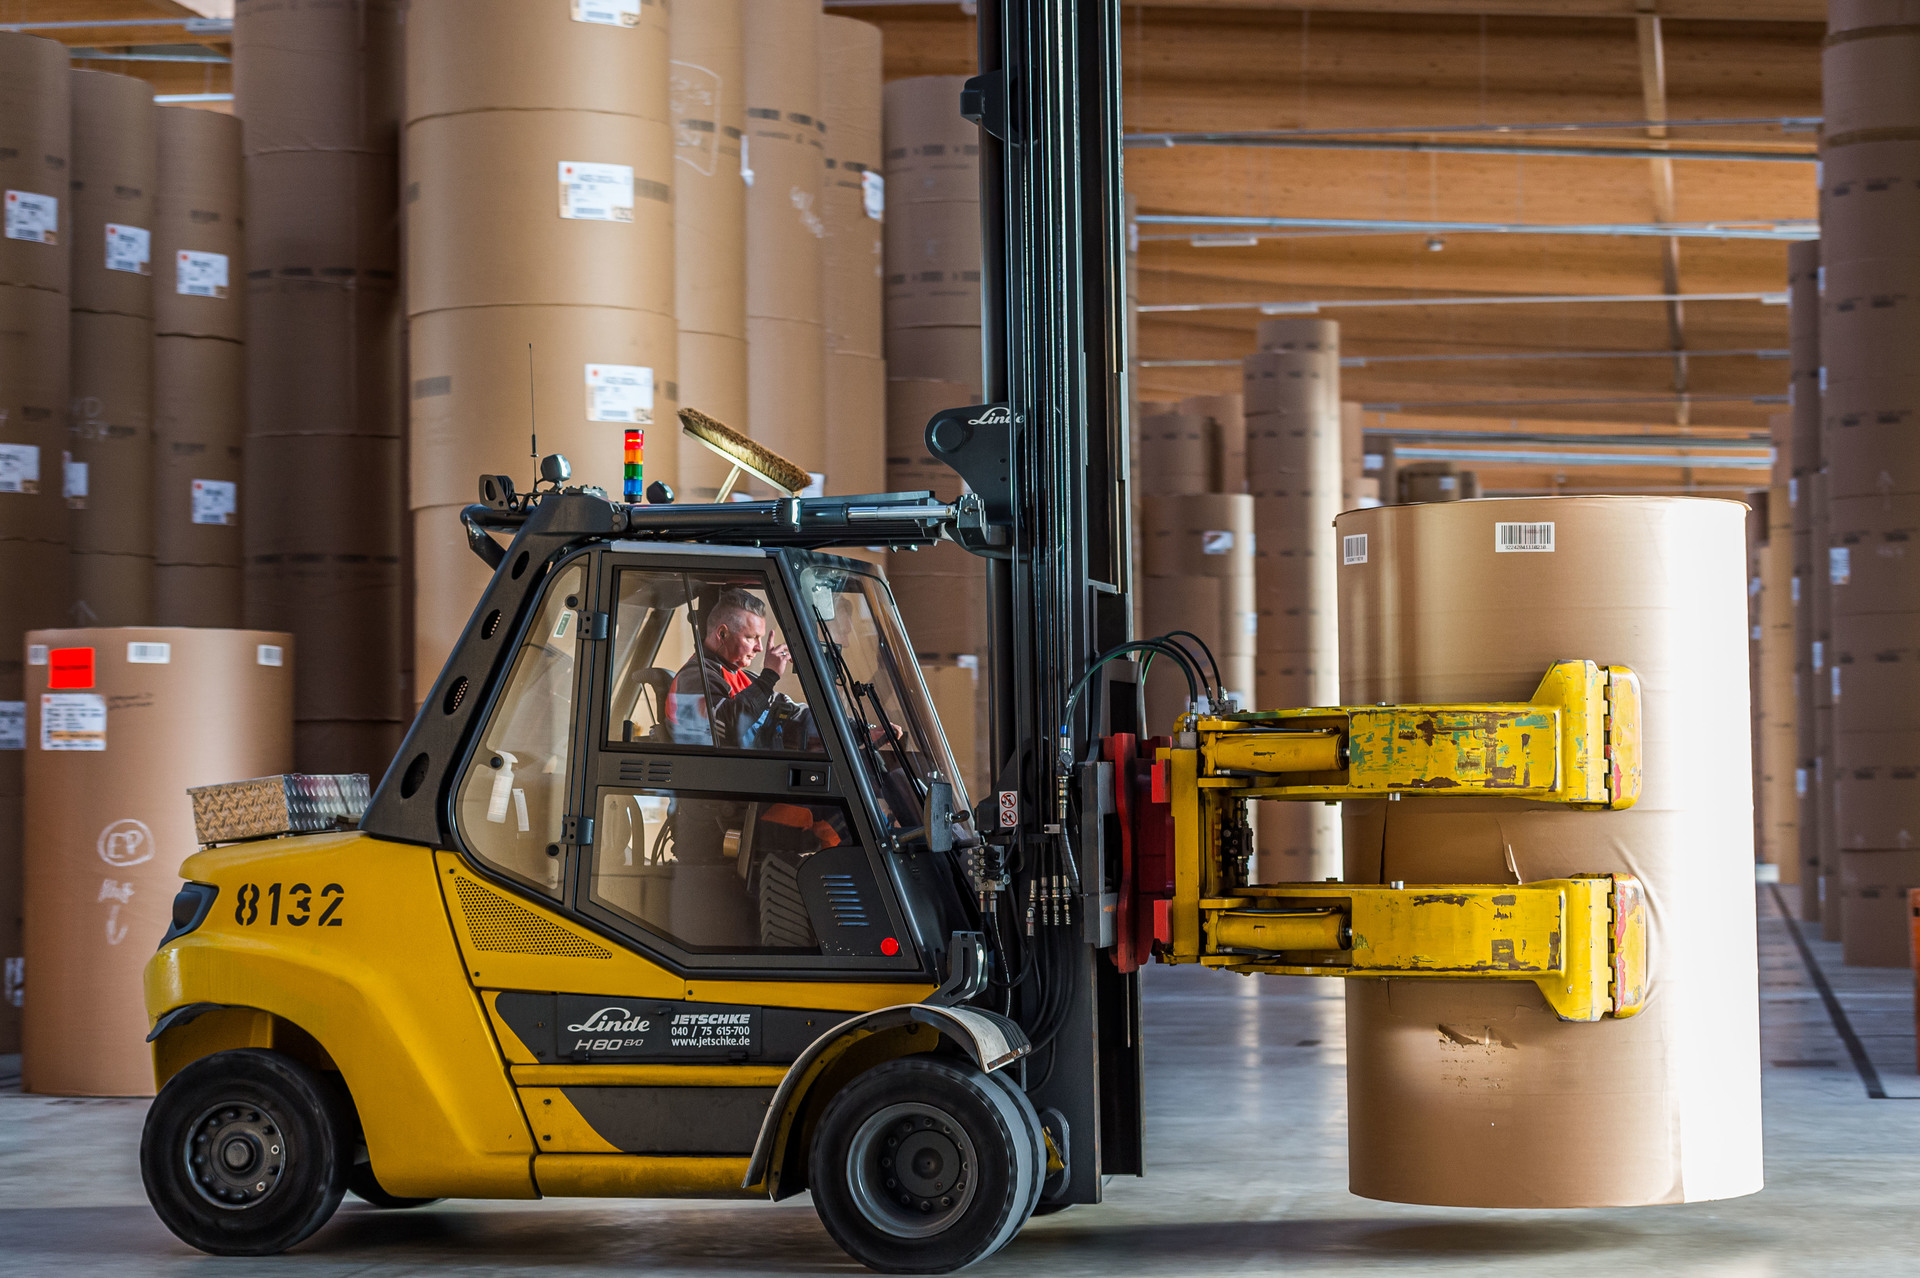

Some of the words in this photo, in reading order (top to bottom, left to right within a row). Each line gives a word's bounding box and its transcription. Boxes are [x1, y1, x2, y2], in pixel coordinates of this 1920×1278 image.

[234, 882, 345, 927] 8132
[567, 1006, 650, 1033] Linde
[671, 1013, 751, 1025] JETSCHKE
[671, 1026, 689, 1036] 040
[691, 1026, 698, 1038] /
[701, 1026, 713, 1036] 75
[715, 1026, 751, 1036] 615-700
[623, 1038, 644, 1047] EVO
[671, 1036, 751, 1048] www.jetschke.de
